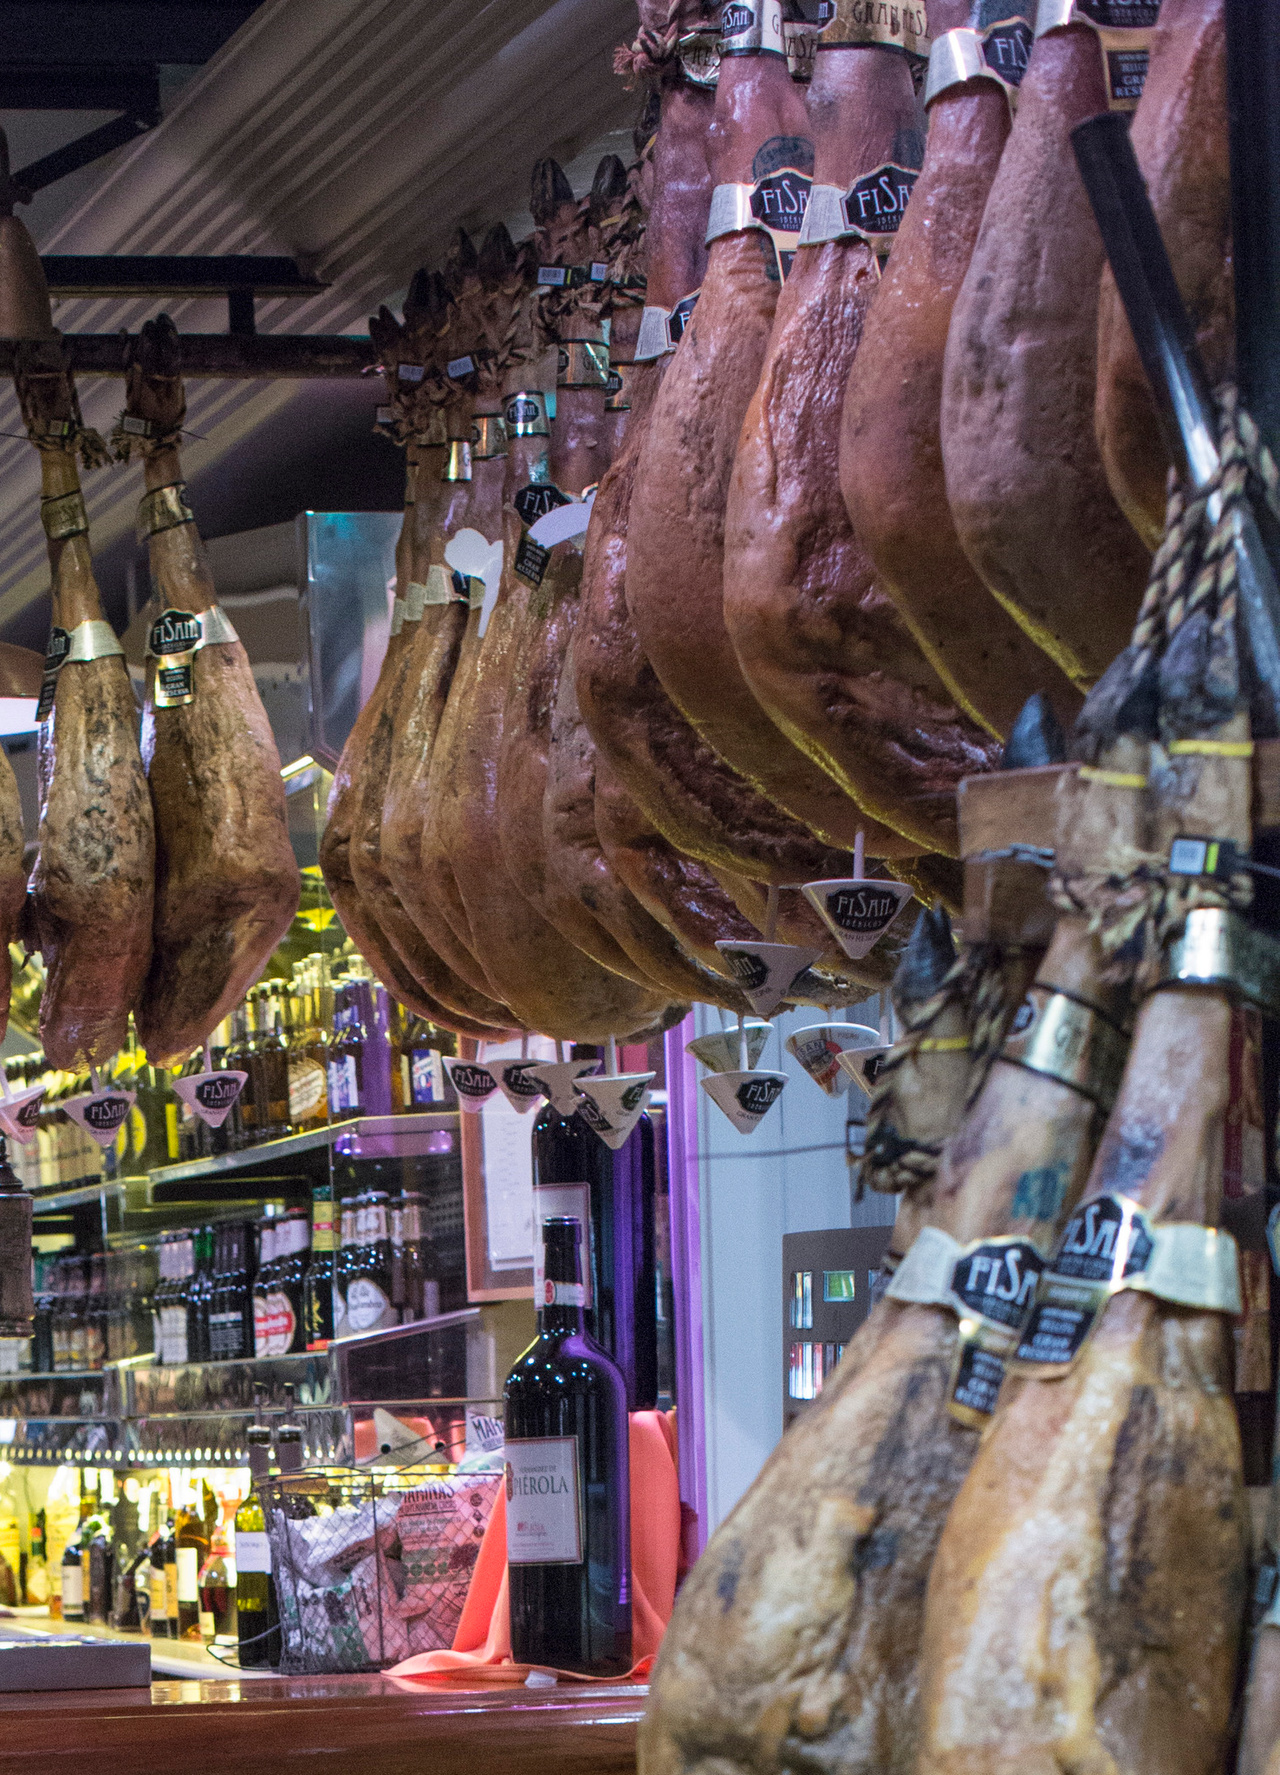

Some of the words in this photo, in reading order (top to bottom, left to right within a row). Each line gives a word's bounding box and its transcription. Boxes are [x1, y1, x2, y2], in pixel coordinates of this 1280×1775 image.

[761, 180, 808, 214] FISA
[857, 176, 910, 217] FISA
[153, 617, 199, 646] FISAN
[837, 891, 891, 917] FISAN
[203, 1080, 237, 1099] FISAN
[454, 1068, 492, 1088] FISAN
[91, 1101, 128, 1119] FISAN
[965, 1249, 1038, 1306] FISA
[513, 1474, 569, 1495] PIÉROLA
